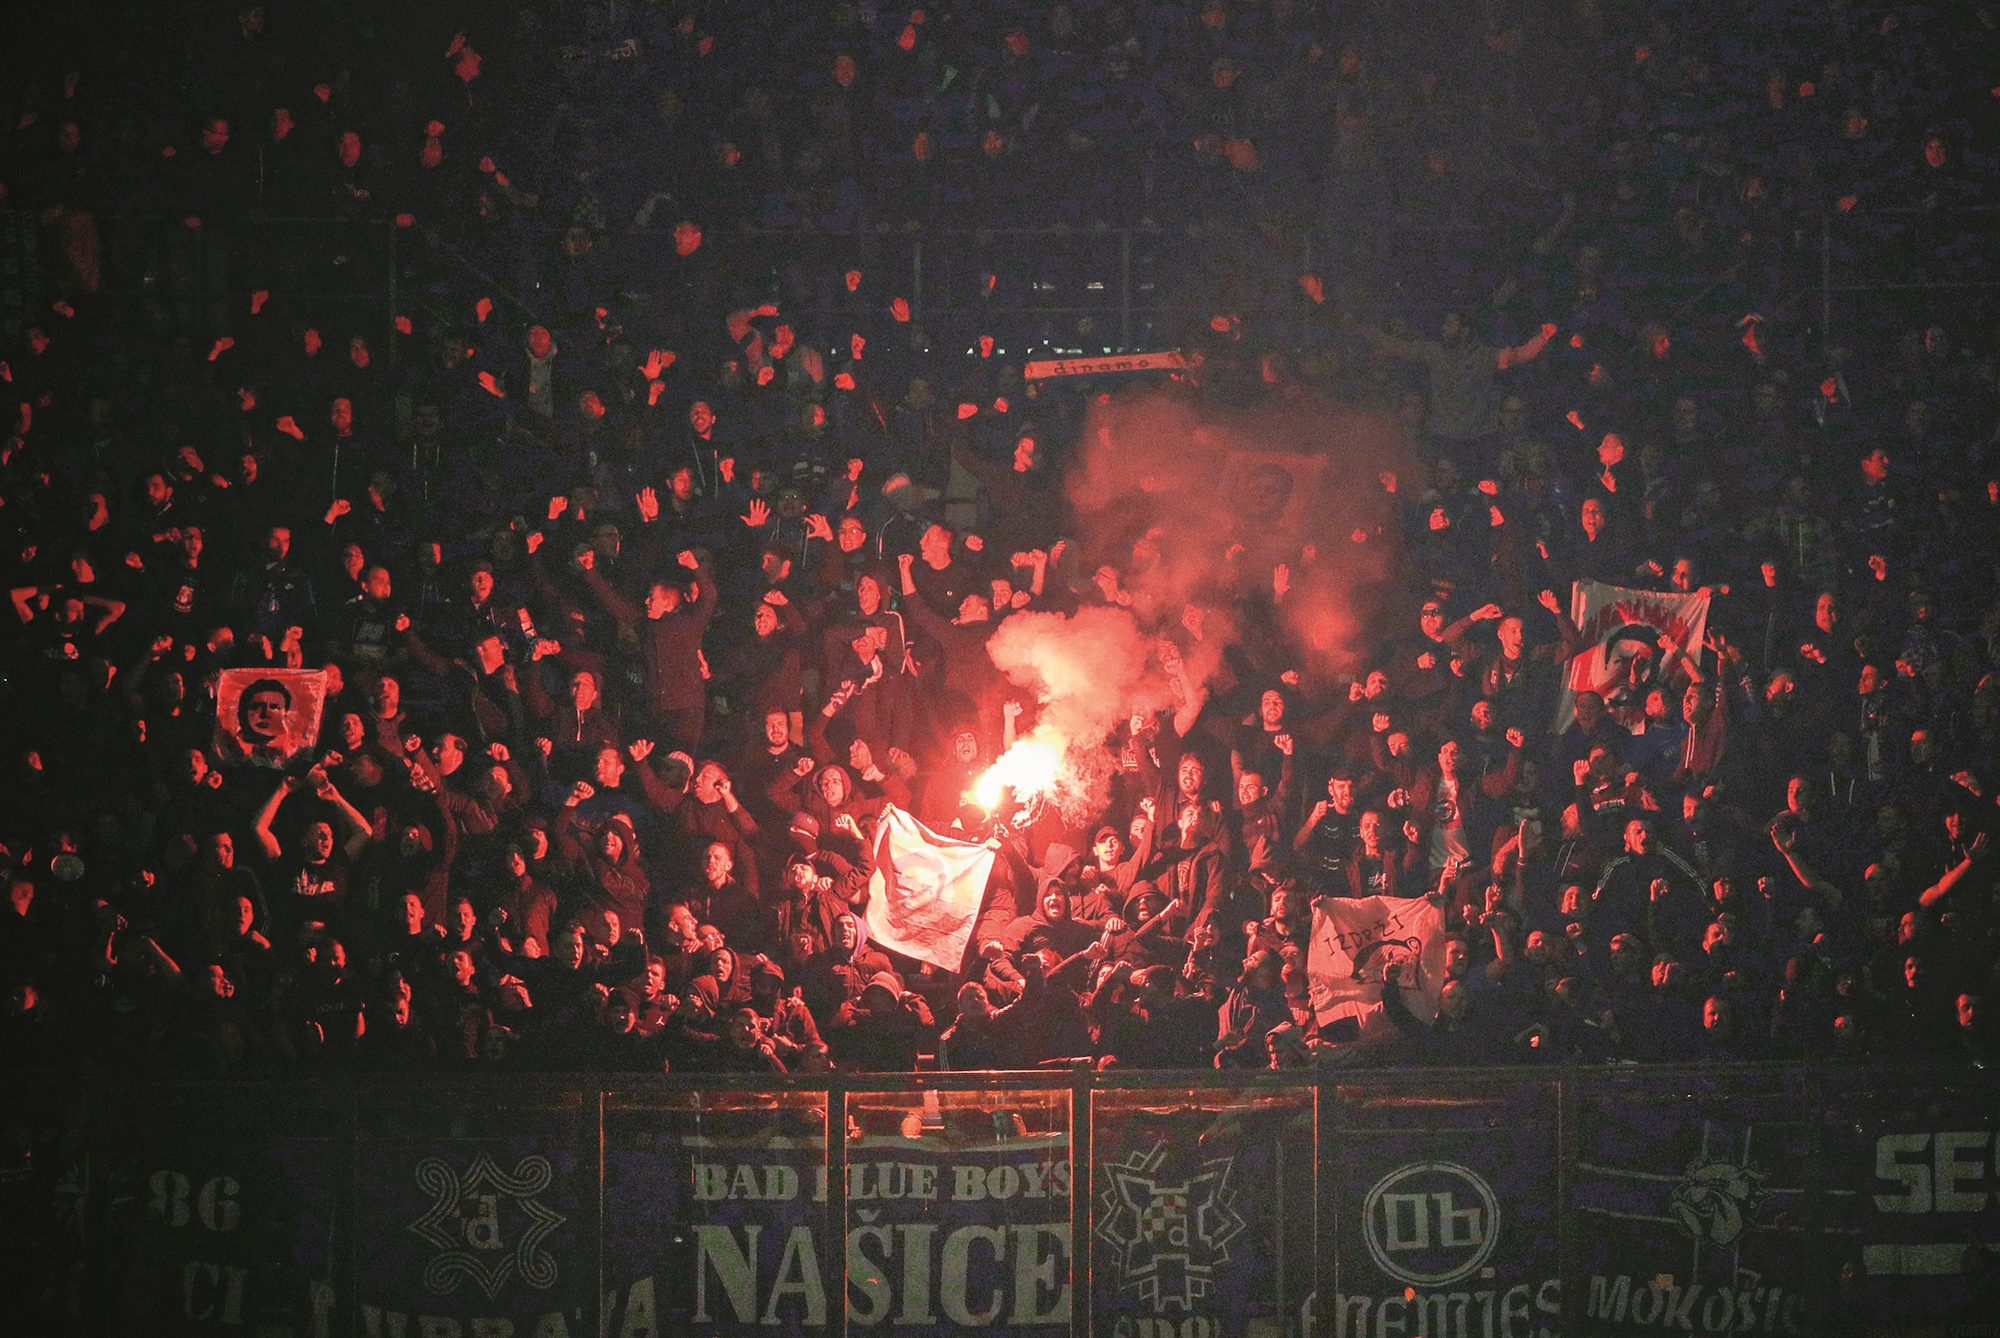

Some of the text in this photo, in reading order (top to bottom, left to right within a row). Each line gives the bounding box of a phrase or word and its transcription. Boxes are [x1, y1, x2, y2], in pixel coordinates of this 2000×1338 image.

[1053, 359, 1150, 376] dinamo
[147, 1169, 241, 1233] 86
[692, 1163, 799, 1200] BAD
[952, 1160, 1070, 1200] BOYS
[1873, 1131, 2000, 1213] SE
[691, 1209, 1072, 1326] NAŠICE
